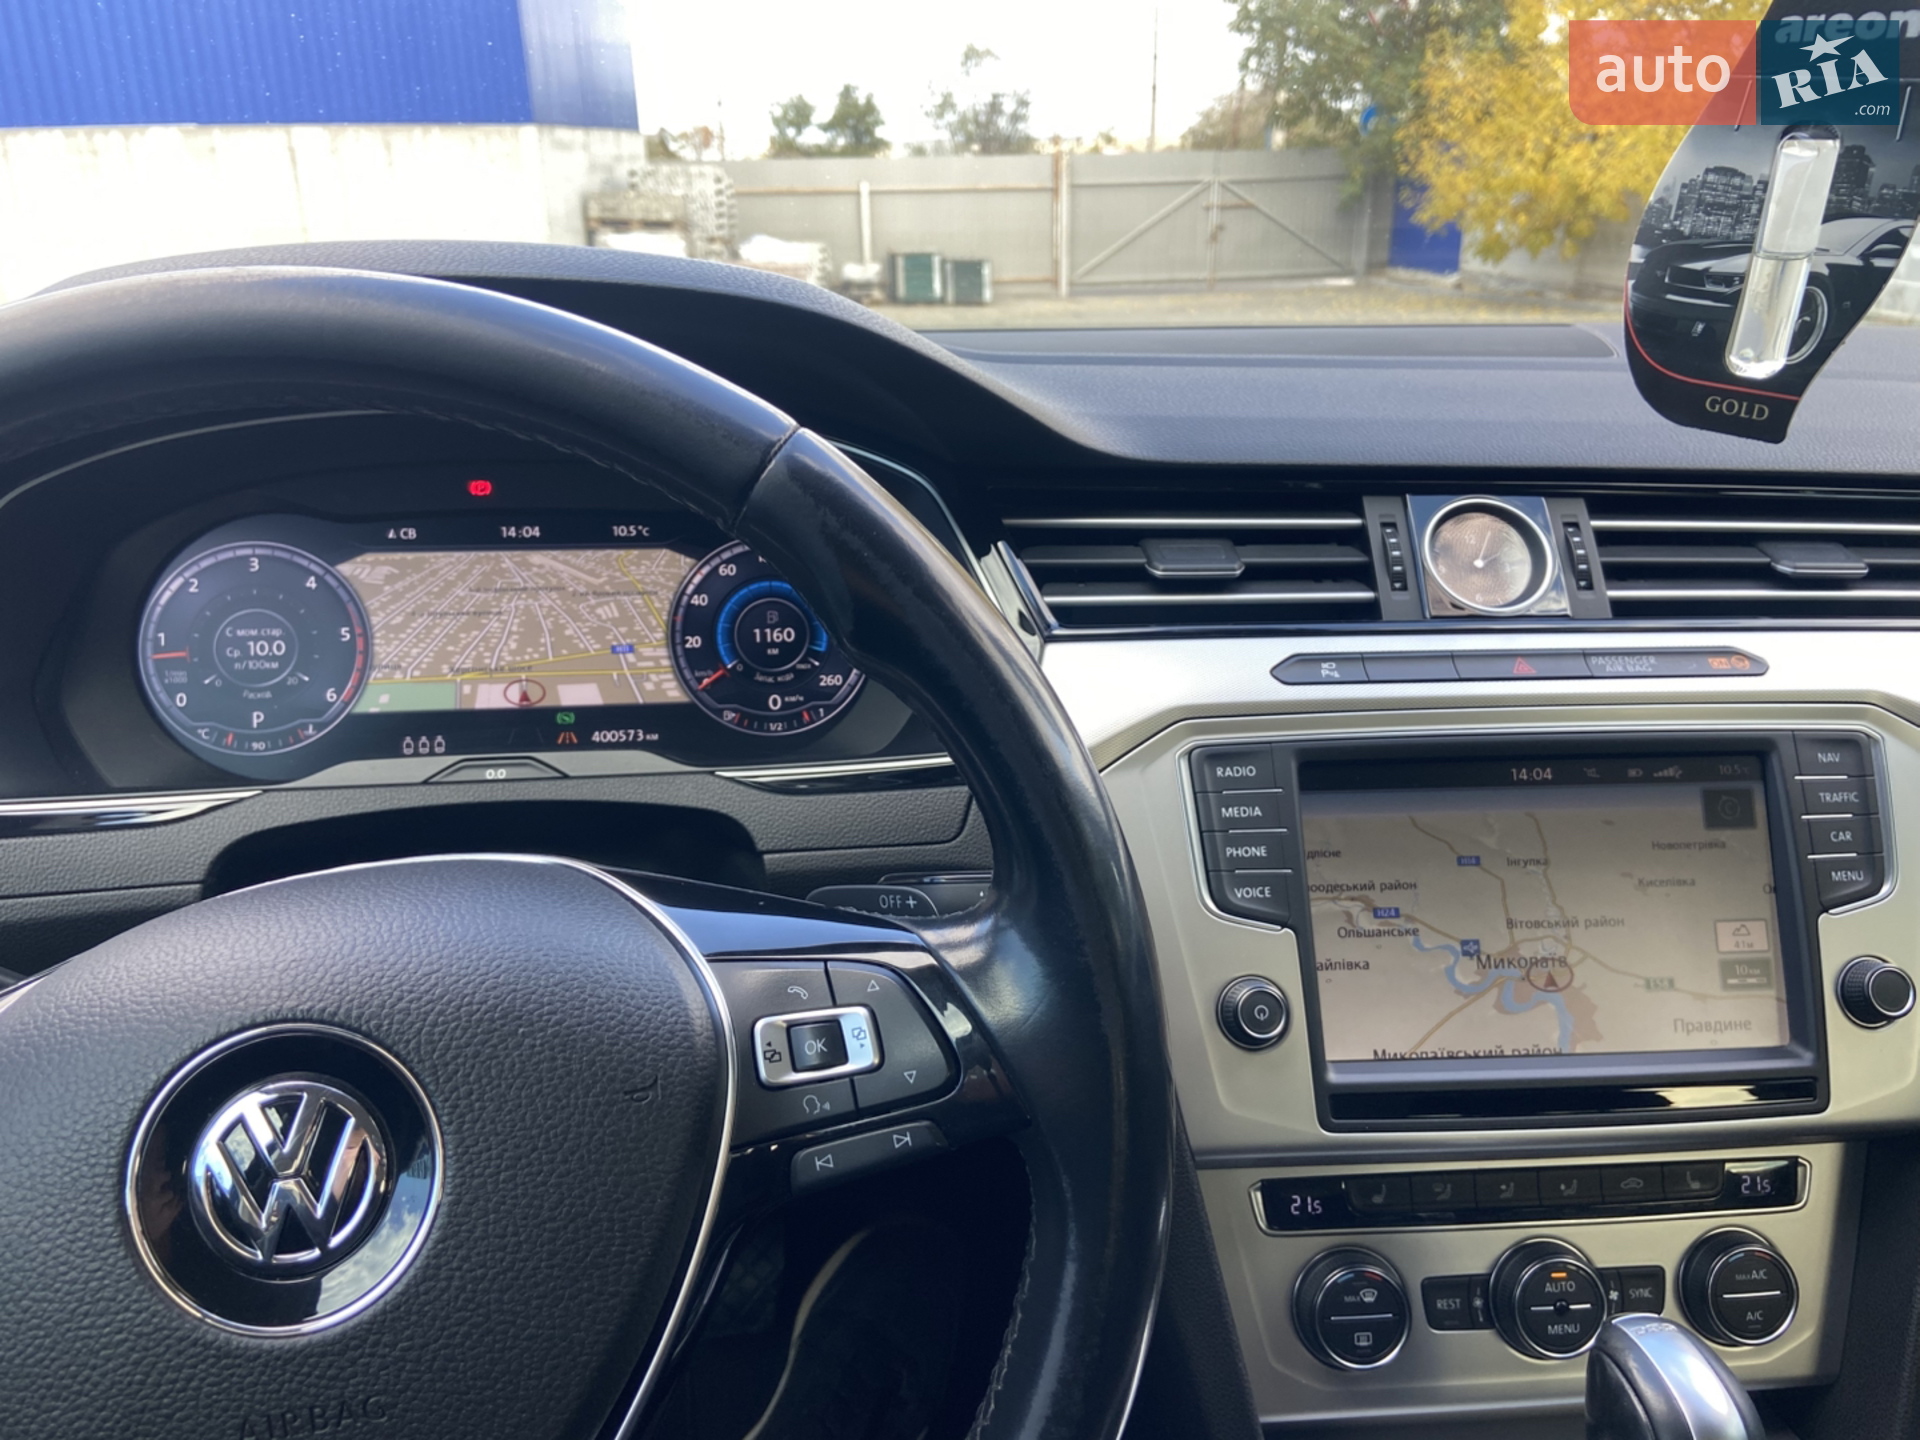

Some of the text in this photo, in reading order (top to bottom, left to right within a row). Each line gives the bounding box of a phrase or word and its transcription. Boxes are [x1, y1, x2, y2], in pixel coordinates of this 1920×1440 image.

[1705, 396, 1769, 420] GOLD
[501, 526, 541, 538] 14:04
[249, 557, 260, 572] 3
[718, 563, 737, 576] 60
[189, 578, 199, 592] 2
[305, 575, 317, 589] 4
[690, 594, 708, 606] 40
[157, 632, 165, 646] 1
[340, 627, 350, 641] 5
[753, 627, 795, 643] 1160
[247, 640, 286, 656] 10.0
[684, 635, 702, 649] 20
[1591, 655, 1658, 665] PASSENGER
[819, 674, 843, 687] 260
[176, 692, 187, 707] 0
[326, 688, 337, 702] 6
[768, 693, 782, 711] 0
[253, 711, 264, 728] P
[591, 729, 644, 743] 400573
[251, 742, 266, 751] 90
[1817, 752, 1841, 763] NAV
[1215, 765, 1257, 778] RADIO
[1511, 768, 1553, 781] 14:04
[1819, 791, 1860, 803] TRAFFIC
[1221, 806, 1263, 818] MEDIA
[1830, 831, 1853, 842] CAR
[1226, 846, 1268, 858] PHONE
[1831, 870, 1865, 882] MENU
[1234, 886, 1272, 899] VOICE
[1506, 915, 1626, 930] Вітовський район
[1673, 1018, 1753, 1036] Правдине
[804, 1038, 829, 1055] OK
[1752, 1268, 1767, 1279] A/C
[1545, 1281, 1576, 1293] AUTO
[1629, 1287, 1653, 1299] SYNC
[1436, 1299, 1461, 1310] REST
[1746, 1310, 1764, 1321] A/C
[1547, 1323, 1580, 1335] MENU
